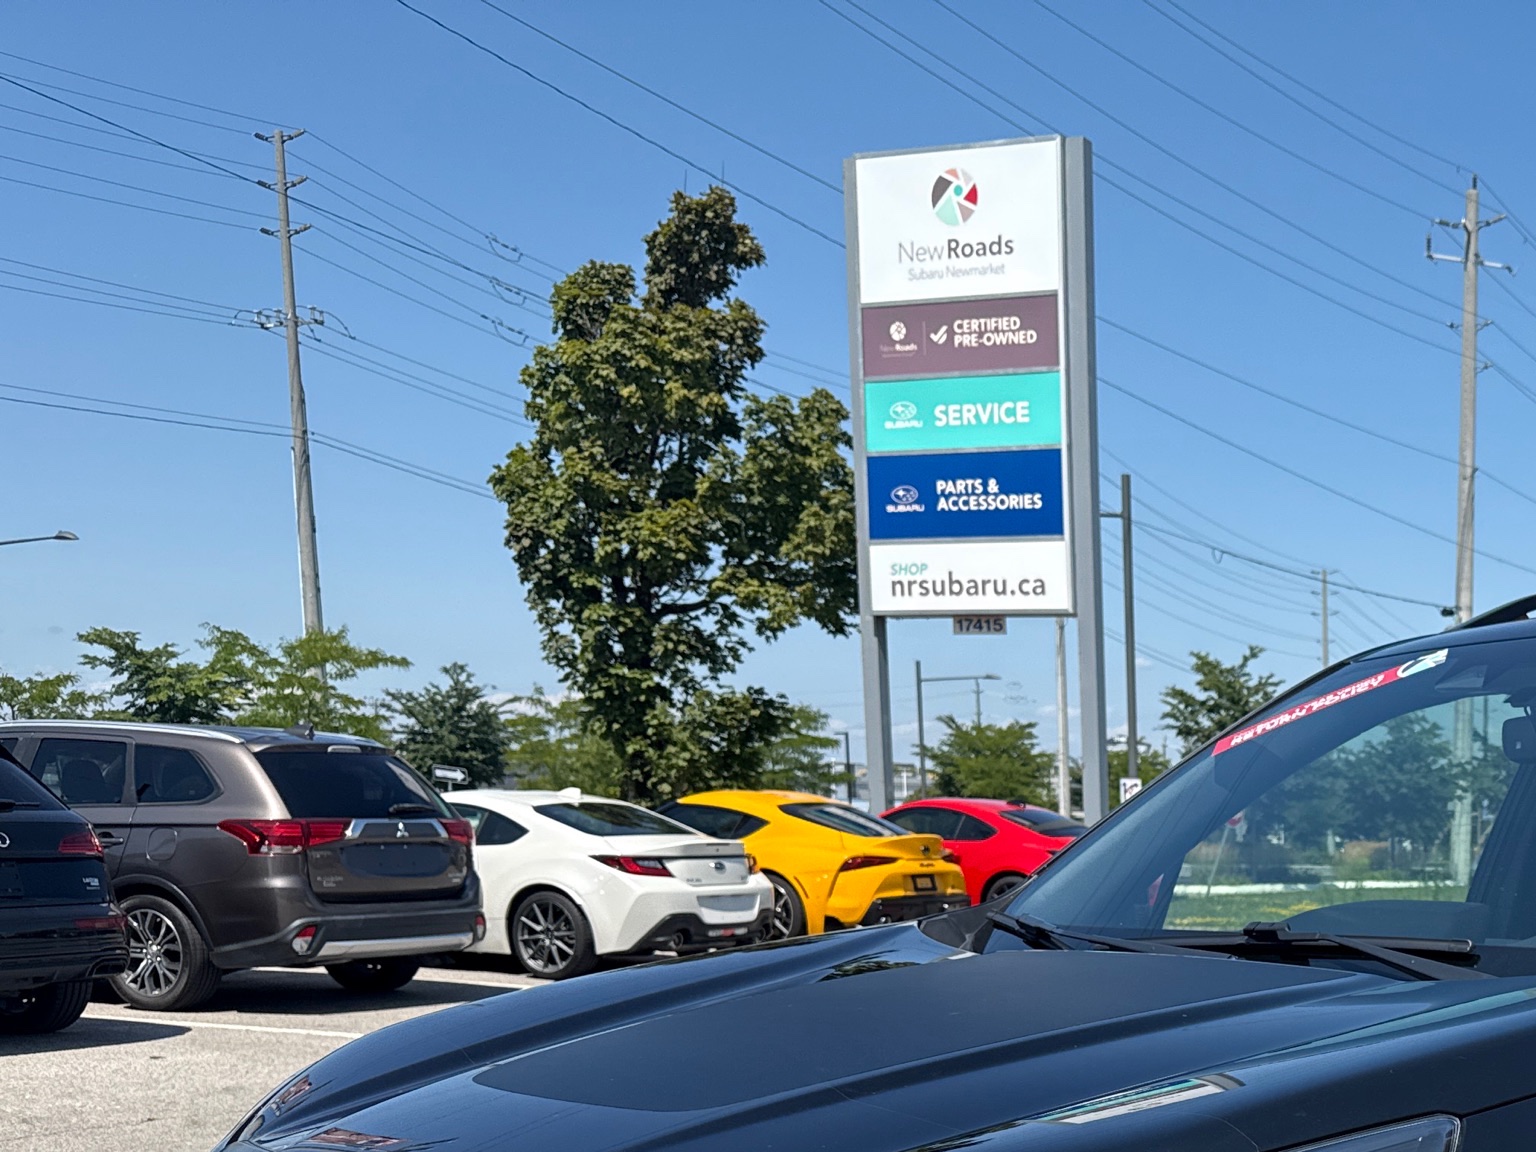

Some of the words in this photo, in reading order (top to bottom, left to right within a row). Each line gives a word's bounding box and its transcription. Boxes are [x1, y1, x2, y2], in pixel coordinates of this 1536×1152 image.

[907, 267, 944, 282] Subaru
[945, 263, 1006, 278] Newmarket
[953, 316, 1021, 332] CERTIFIED
[953, 331, 1037, 348] PRE-OWNED
[933, 401, 1030, 427] SERVICE
[884, 420, 923, 429] SUBARU
[936, 479, 983, 495] PARTS
[986, 477, 1000, 494] &
[886, 504, 925, 513] SUBARU
[936, 493, 1043, 512] ACCESSORIES
[890, 563, 929, 577] SHOP
[890, 571, 1047, 598] nrsubaru.ca
[956, 617, 1004, 634] 17415
